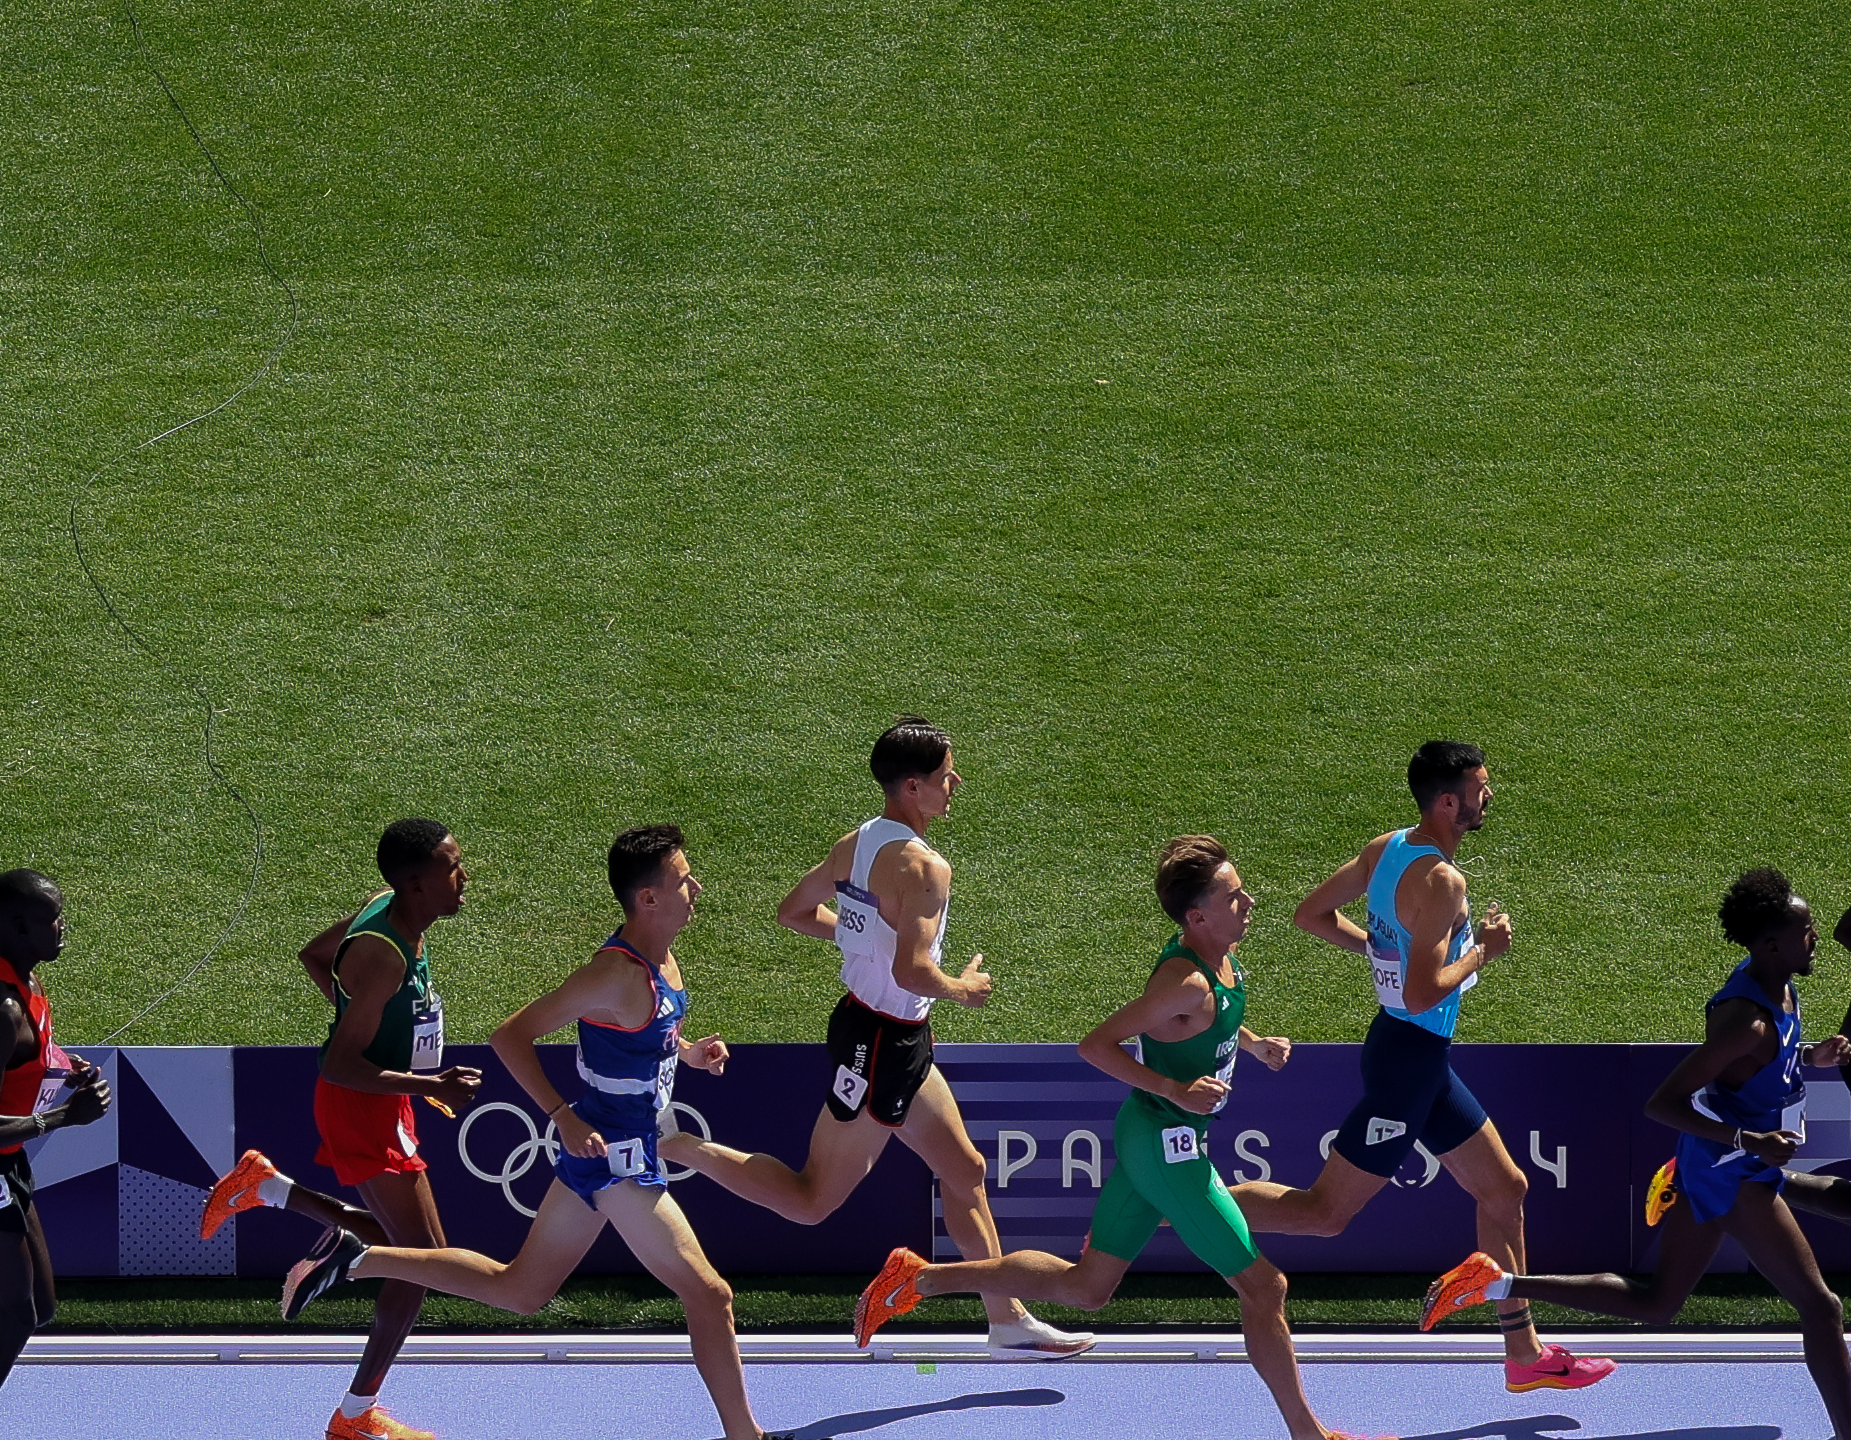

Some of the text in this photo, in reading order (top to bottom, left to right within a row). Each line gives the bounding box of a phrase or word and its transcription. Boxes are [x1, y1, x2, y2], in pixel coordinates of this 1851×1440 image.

[841, 1077, 856, 1101] 2
[1169, 1133, 1193, 1154] 18
[618, 1146, 634, 1170] 7
